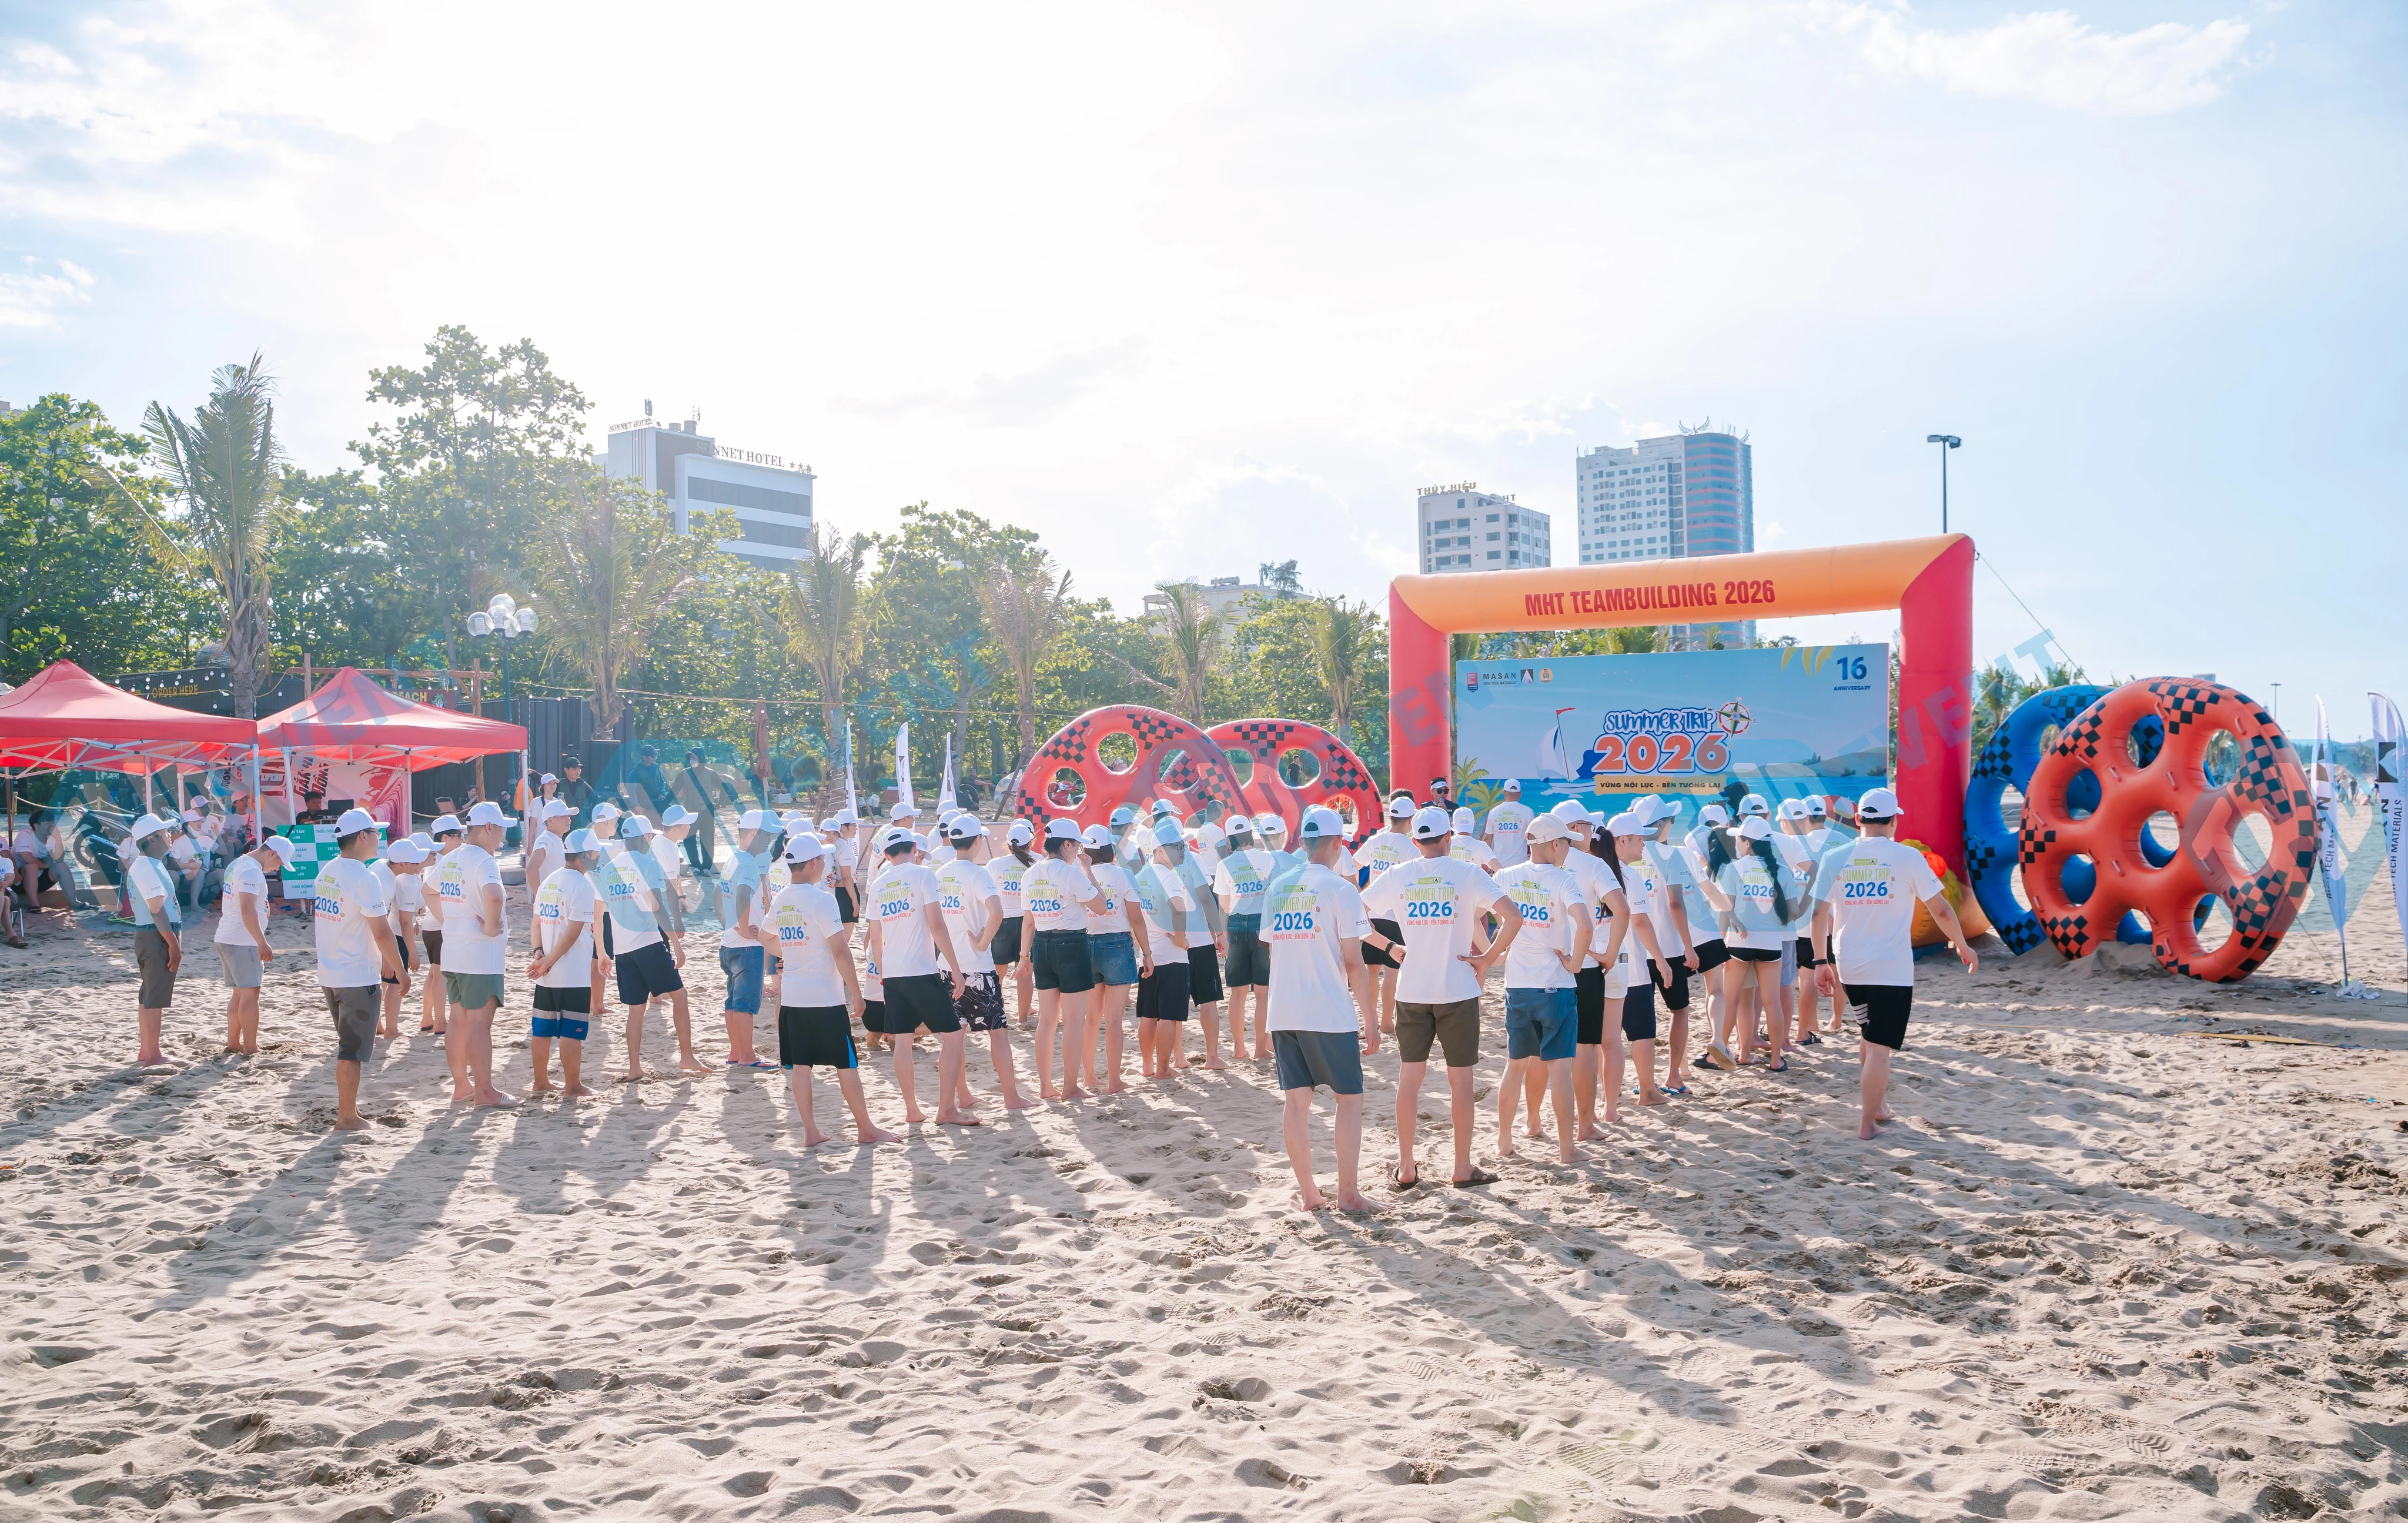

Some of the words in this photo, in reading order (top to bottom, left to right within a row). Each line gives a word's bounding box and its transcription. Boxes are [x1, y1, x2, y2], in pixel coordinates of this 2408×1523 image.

[609, 422, 632, 432] SONNET
[633, 418, 653, 428] HOTEL
[747, 451, 785, 467] HOTEL
[1525, 592, 1564, 616] MHT
[1570, 582, 1717, 613] TEAMBUILDING
[1724, 579, 1775, 604] 2026
[1837, 656, 1867, 680] 16
[152, 686, 177, 699] ORDER
[180, 684, 199, 696] HERE
[392, 692, 427, 702] EACH
[1683, 710, 1714, 732] TRIP
[1593, 734, 1728, 771] 2026
[1624, 781, 1637, 790] NỘI
[1662, 780, 1676, 788] BỀN
[2393, 799, 2402, 850] MATERIALS
[1232, 873, 1252, 884] SUMMER
[1842, 869, 1872, 881] SUMMER
[1875, 868, 1890, 880] TRIP
[440, 881, 461, 896] 2026
[608, 883, 635, 896] 2026
[1004, 881, 1021, 891] 202
[1235, 881, 1263, 893] 2026
[1844, 881, 1888, 897] 2026
[878, 889, 899, 903] SUMMER
[900, 887, 910, 899] TRIP
[1405, 887, 1436, 901] SUMMER
[1439, 887, 1454, 900] TRIP
[1510, 889, 1534, 904] SUMMER
[1536, 891, 1550, 906] TRIP
[315, 896, 339, 914] 2026
[881, 898, 909, 916] 2026
[942, 896, 959, 908] 026
[1030, 899, 1061, 911] 2026
[1274, 897, 1299, 912] SUMMER
[1301, 896, 1316, 910] TRIP
[1407, 901, 1452, 918] 2026
[1274, 912, 1313, 931] 2026
[780, 926, 804, 940] 2026
